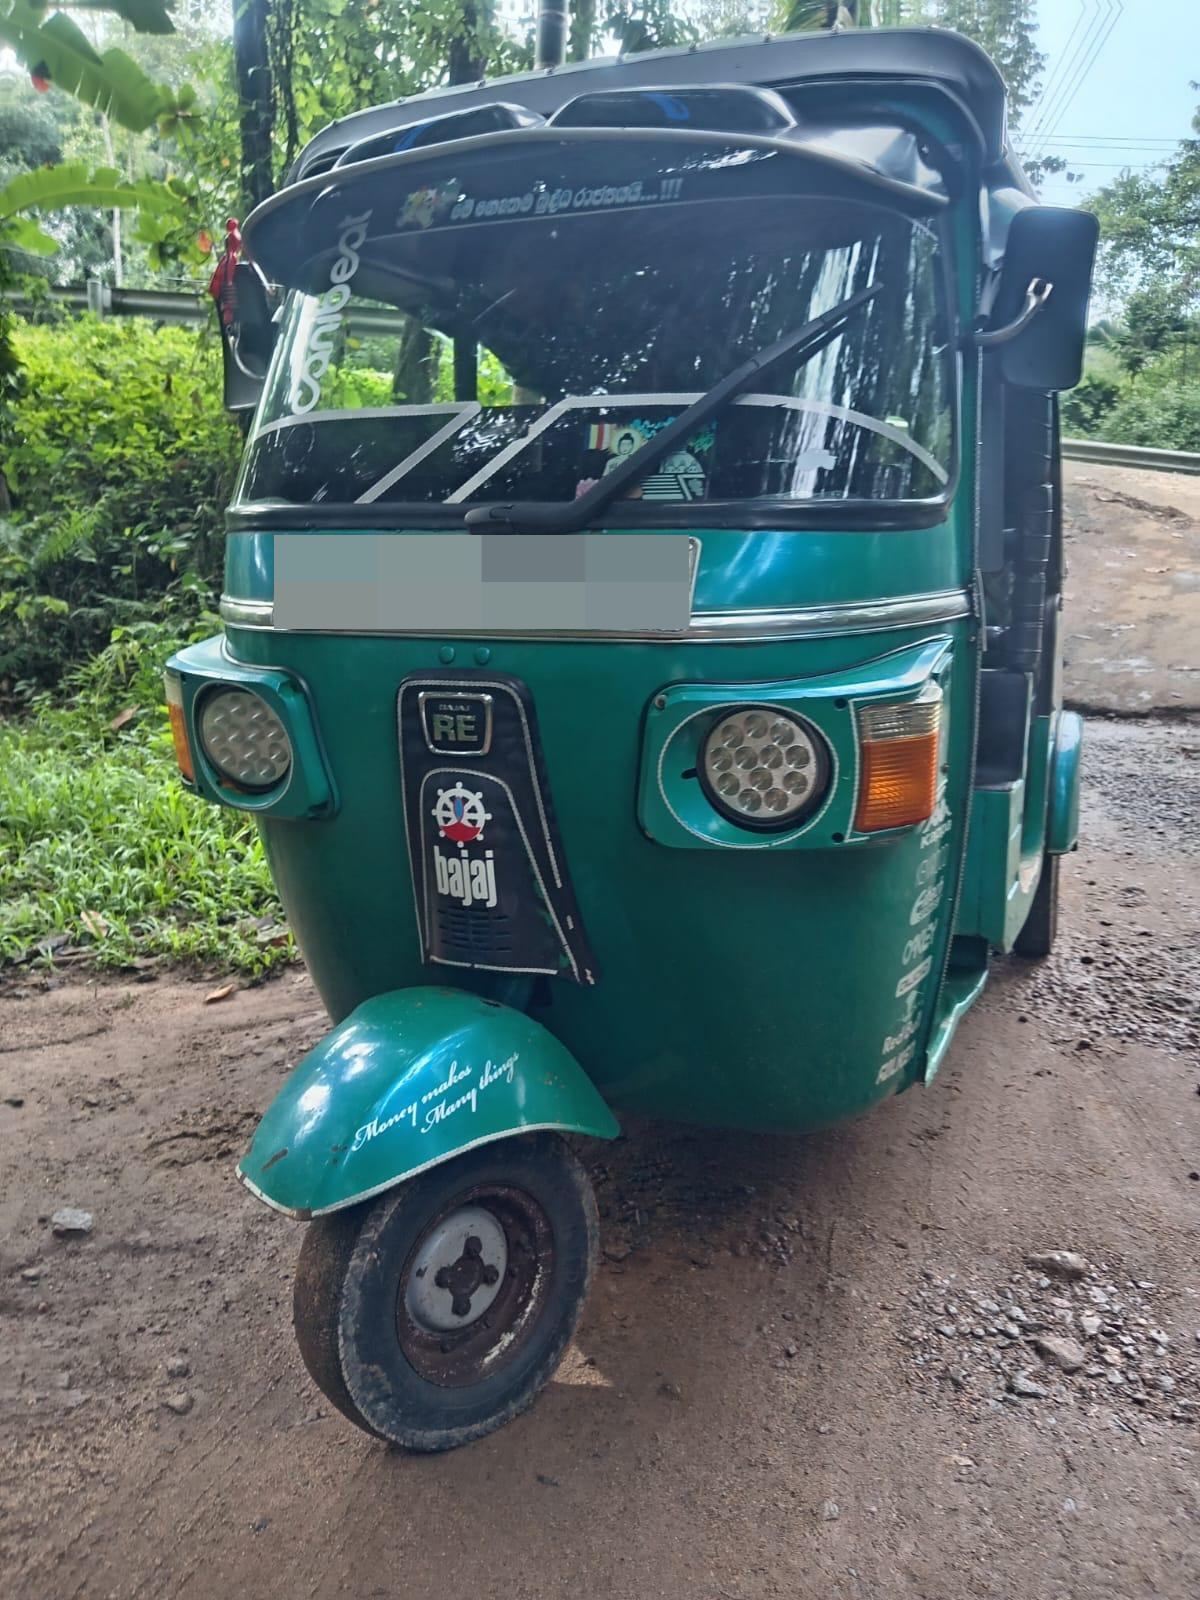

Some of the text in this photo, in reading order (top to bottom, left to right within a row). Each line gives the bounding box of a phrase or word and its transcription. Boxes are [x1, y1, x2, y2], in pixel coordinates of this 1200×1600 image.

[432, 714, 478, 741] RE
[434, 846, 497, 907] bajaj
[351, 1060, 473, 1151] Money makes
[420, 1088, 477, 1134] Many
